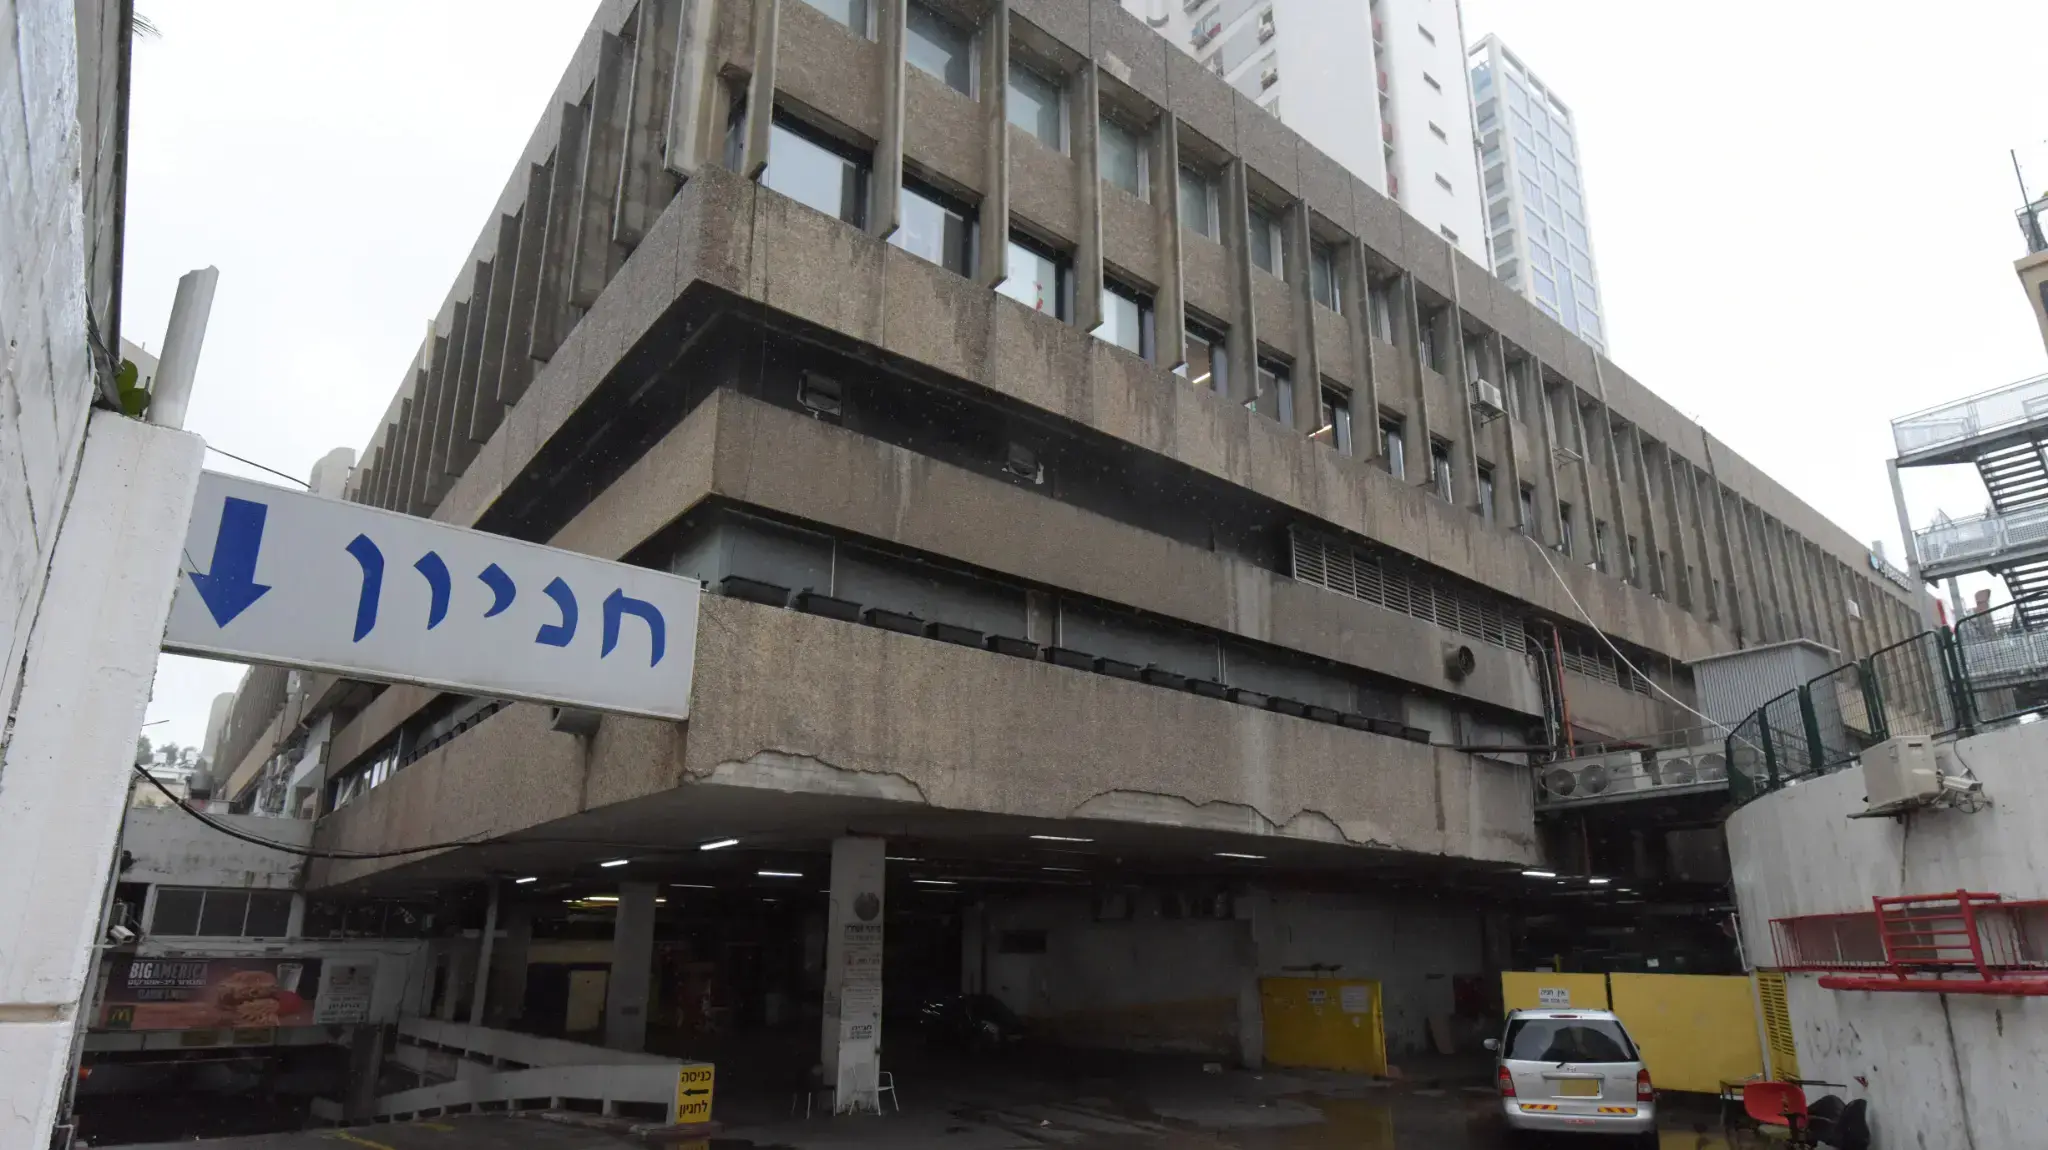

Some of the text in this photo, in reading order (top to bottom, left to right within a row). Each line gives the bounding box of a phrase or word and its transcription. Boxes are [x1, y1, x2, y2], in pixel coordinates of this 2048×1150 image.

[344, 532, 666, 669] חניון
[681, 1070, 712, 1083] כניסה
[679, 1100, 708, 1118] לחניון
